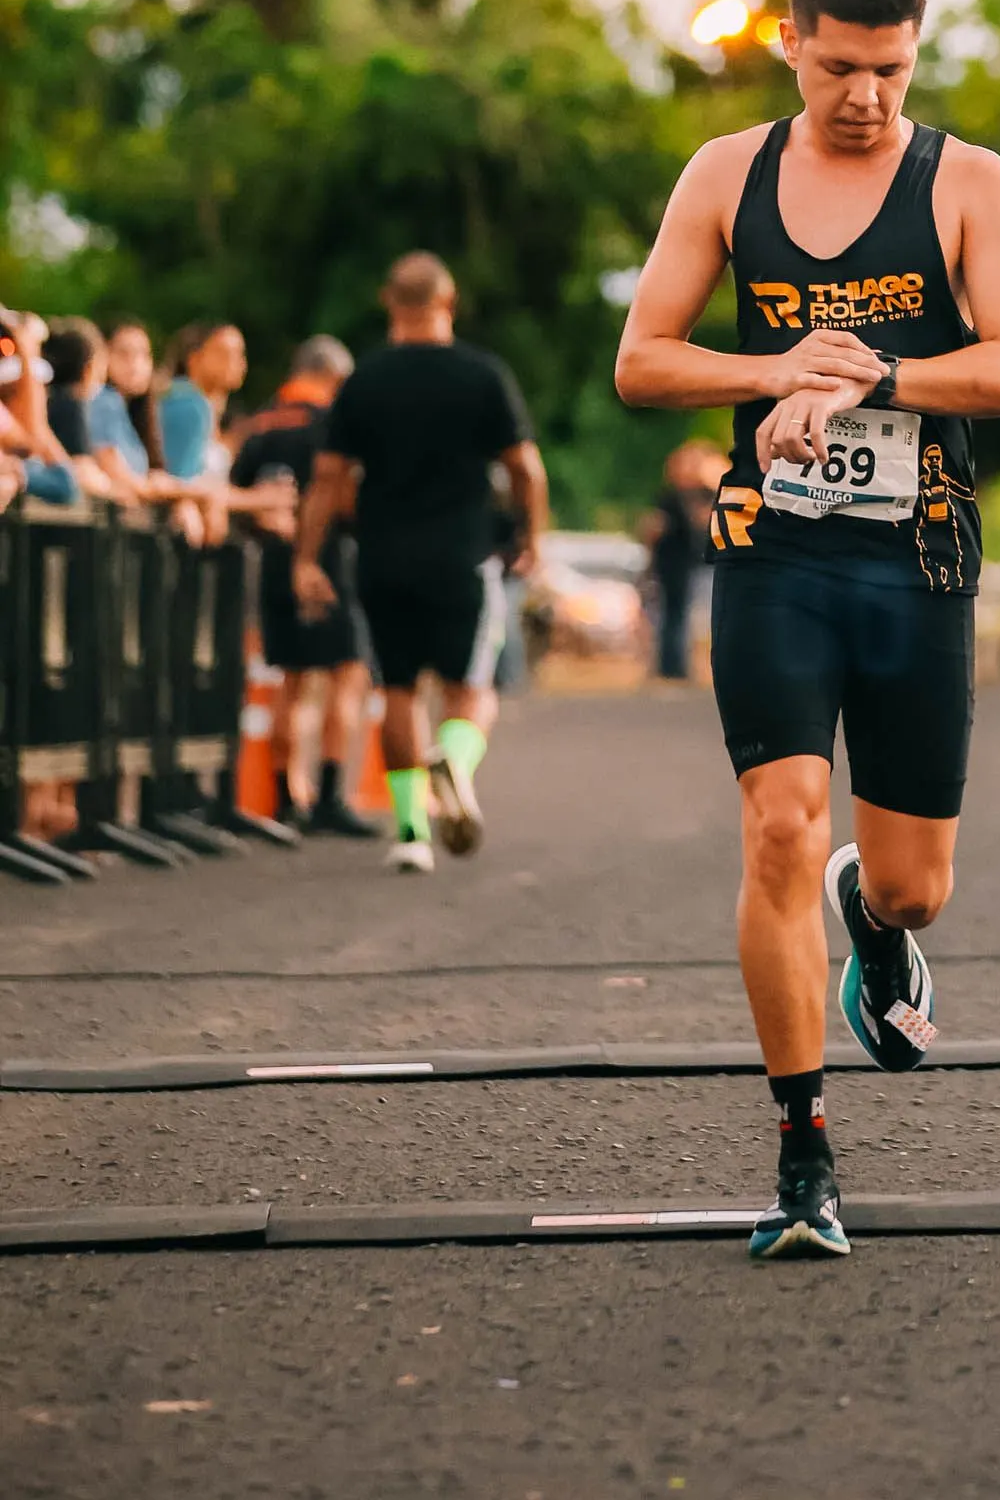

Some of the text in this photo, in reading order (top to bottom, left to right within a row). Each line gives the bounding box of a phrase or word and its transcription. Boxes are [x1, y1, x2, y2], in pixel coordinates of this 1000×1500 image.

[808, 272, 924, 302] THIAGO
[809, 292, 924, 320] ROLAND
[806, 486, 853, 503] THIAGO
